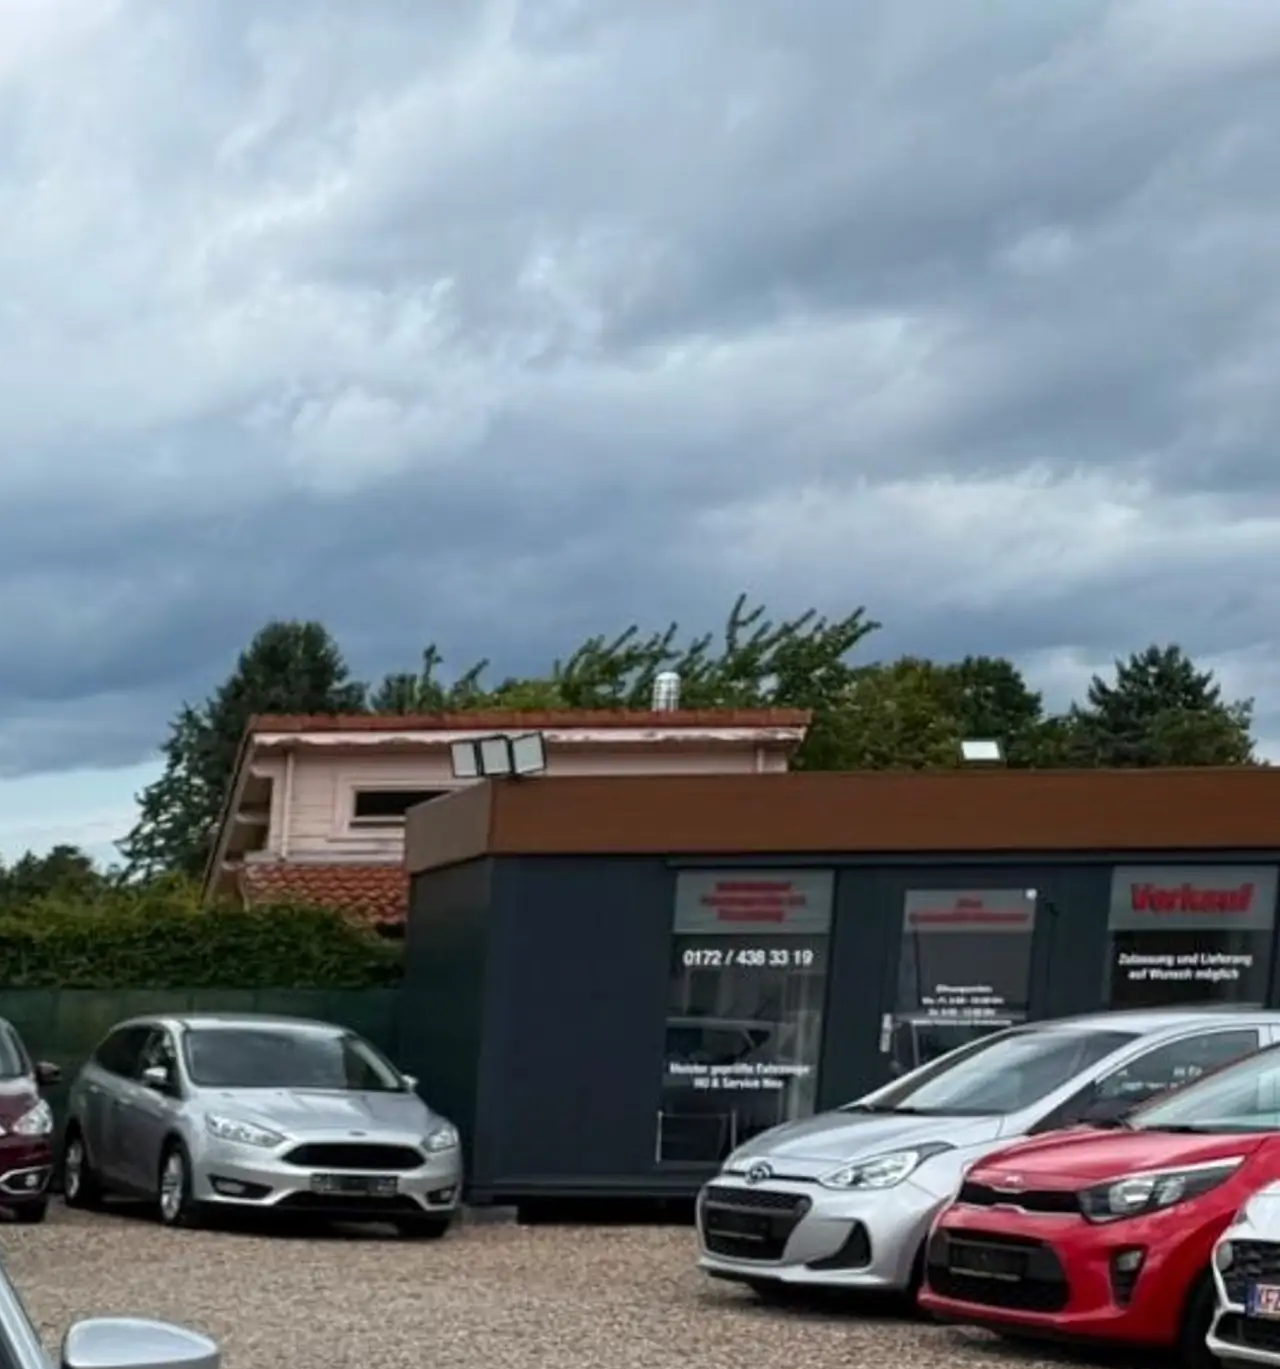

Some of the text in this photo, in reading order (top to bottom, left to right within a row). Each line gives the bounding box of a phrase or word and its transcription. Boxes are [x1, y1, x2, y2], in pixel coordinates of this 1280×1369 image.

[1131, 883, 1254, 913] Verkauf
[683, 949, 722, 966] 0172
[736, 949, 766, 966] 438
[769, 949, 788, 966] 33
[794, 949, 814, 966] 19
[1118, 953, 1253, 967] Zulassung und Lieferung
[1128, 968, 1239, 983] auf Wunsch möglich
